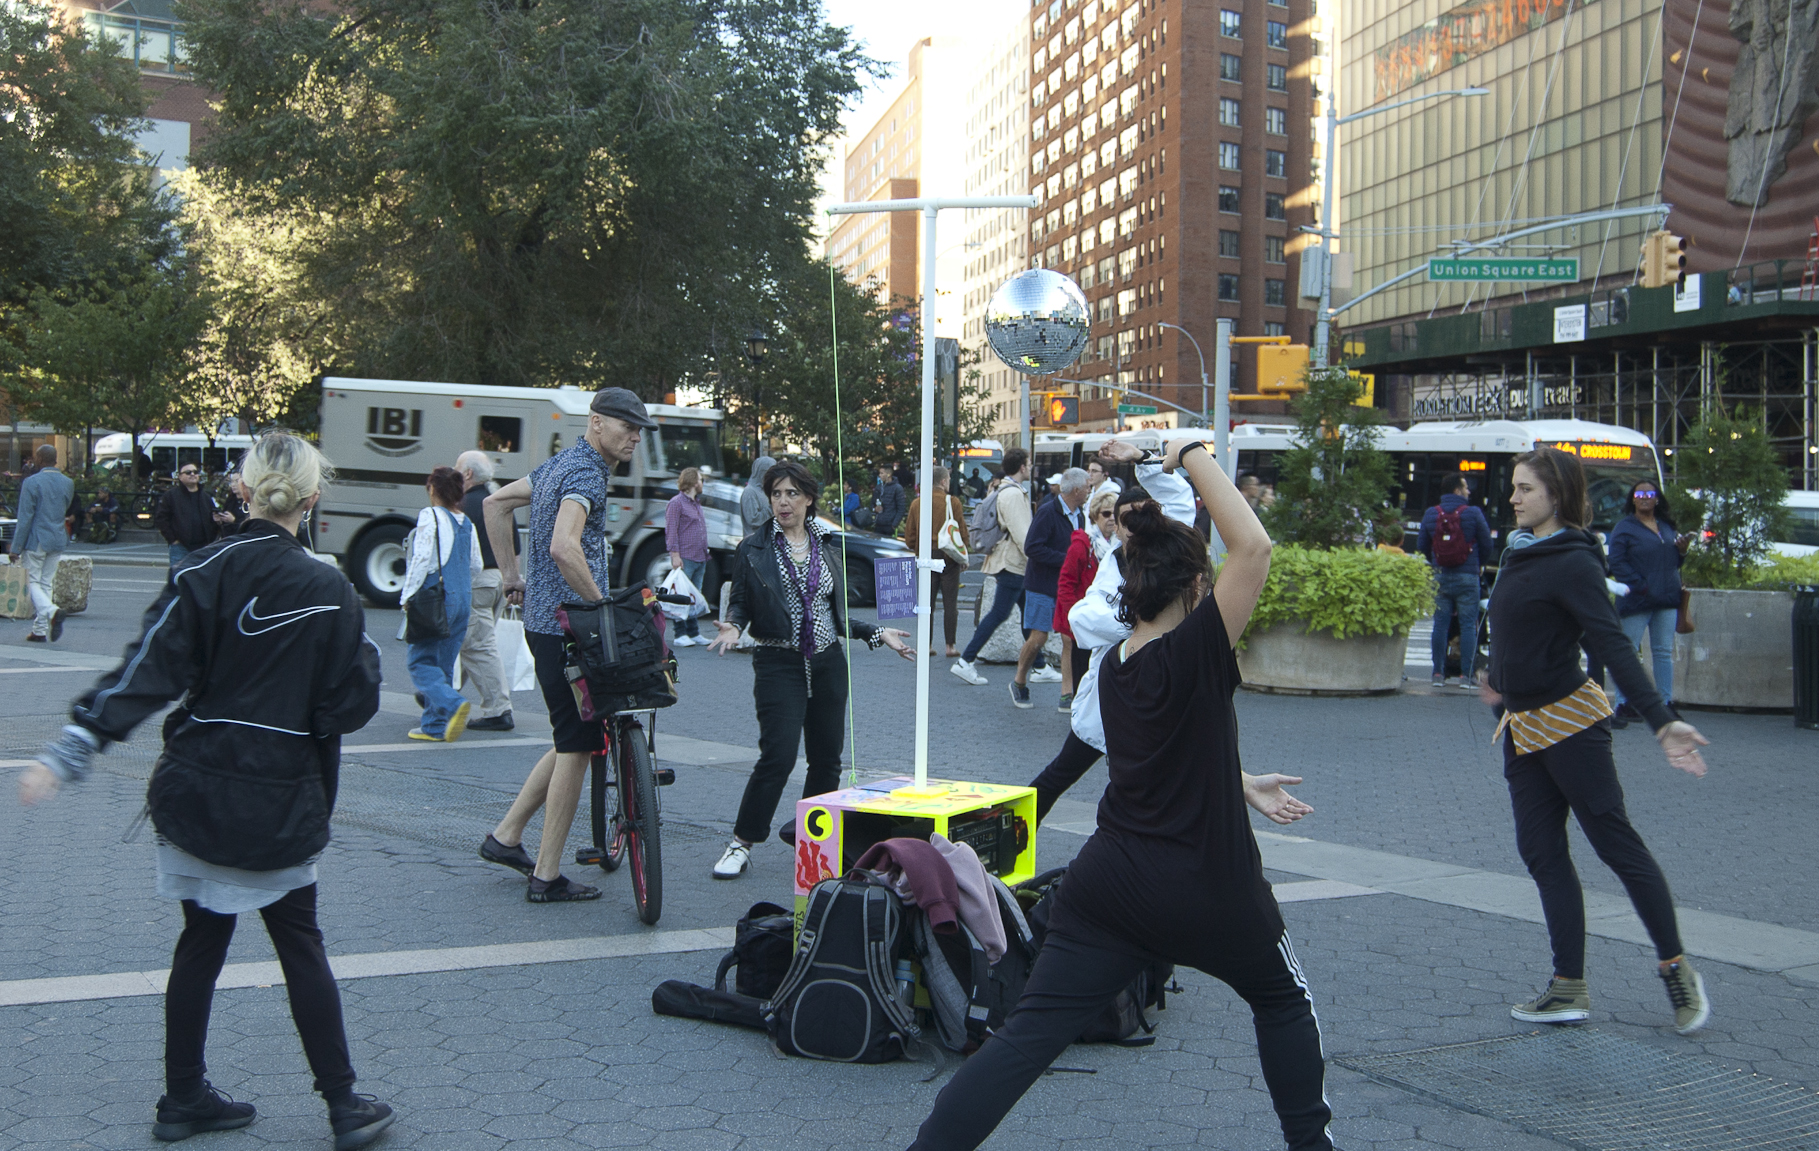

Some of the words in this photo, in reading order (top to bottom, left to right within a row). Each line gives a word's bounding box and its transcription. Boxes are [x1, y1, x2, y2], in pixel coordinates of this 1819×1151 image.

[1434, 264, 1478, 276] Union
[1482, 264, 1535, 278] Square
[1538, 264, 1573, 276] East
[369, 406, 423, 436] IBI
[1580, 443, 1632, 460] CROSSTOWN
